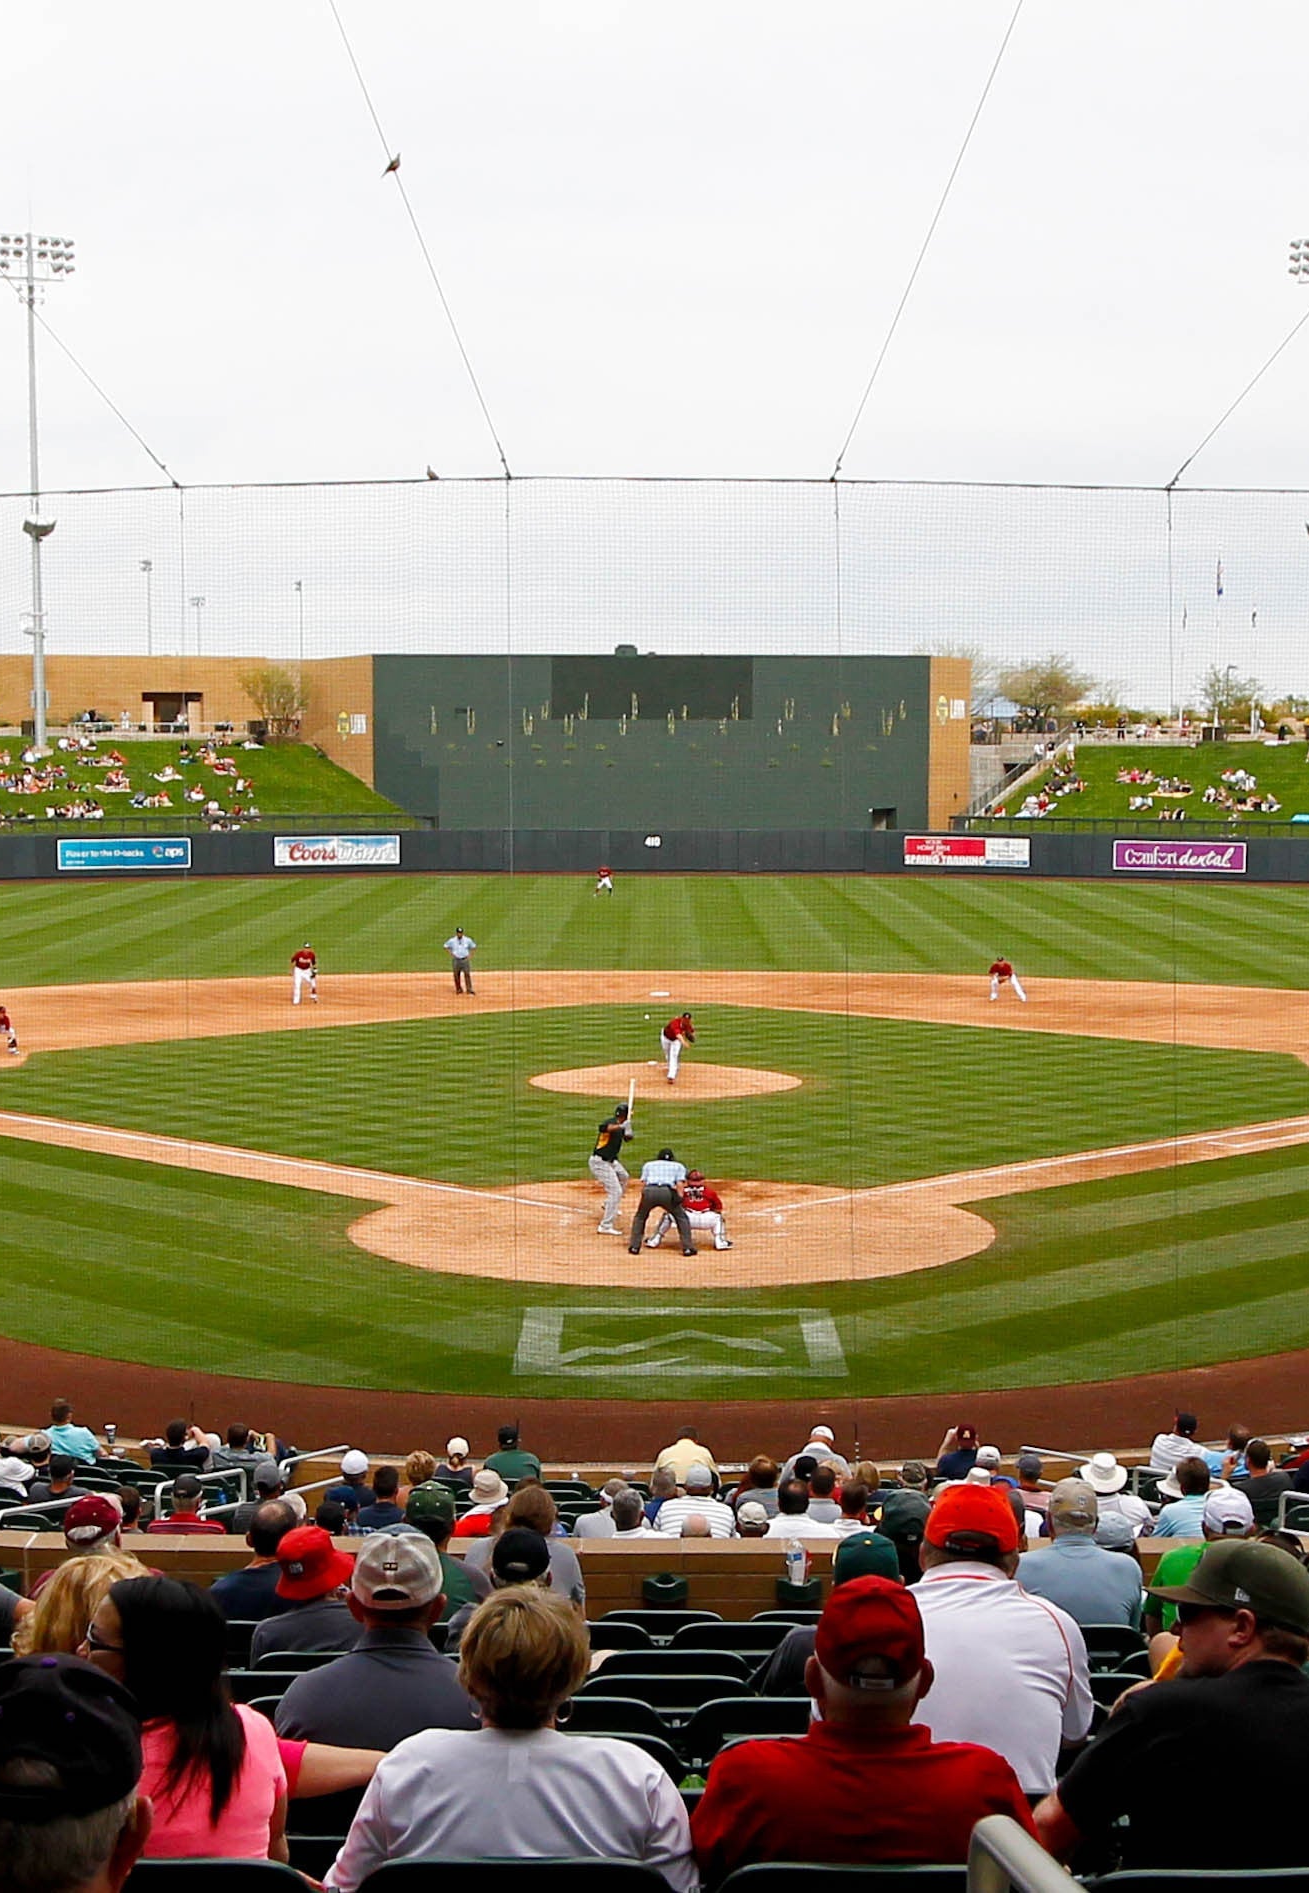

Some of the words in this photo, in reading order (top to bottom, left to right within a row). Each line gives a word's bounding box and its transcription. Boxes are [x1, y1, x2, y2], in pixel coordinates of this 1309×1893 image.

[164, 847, 185, 859] aps
[288, 841, 338, 862] Coors
[337, 846, 398, 862] LIGHT
